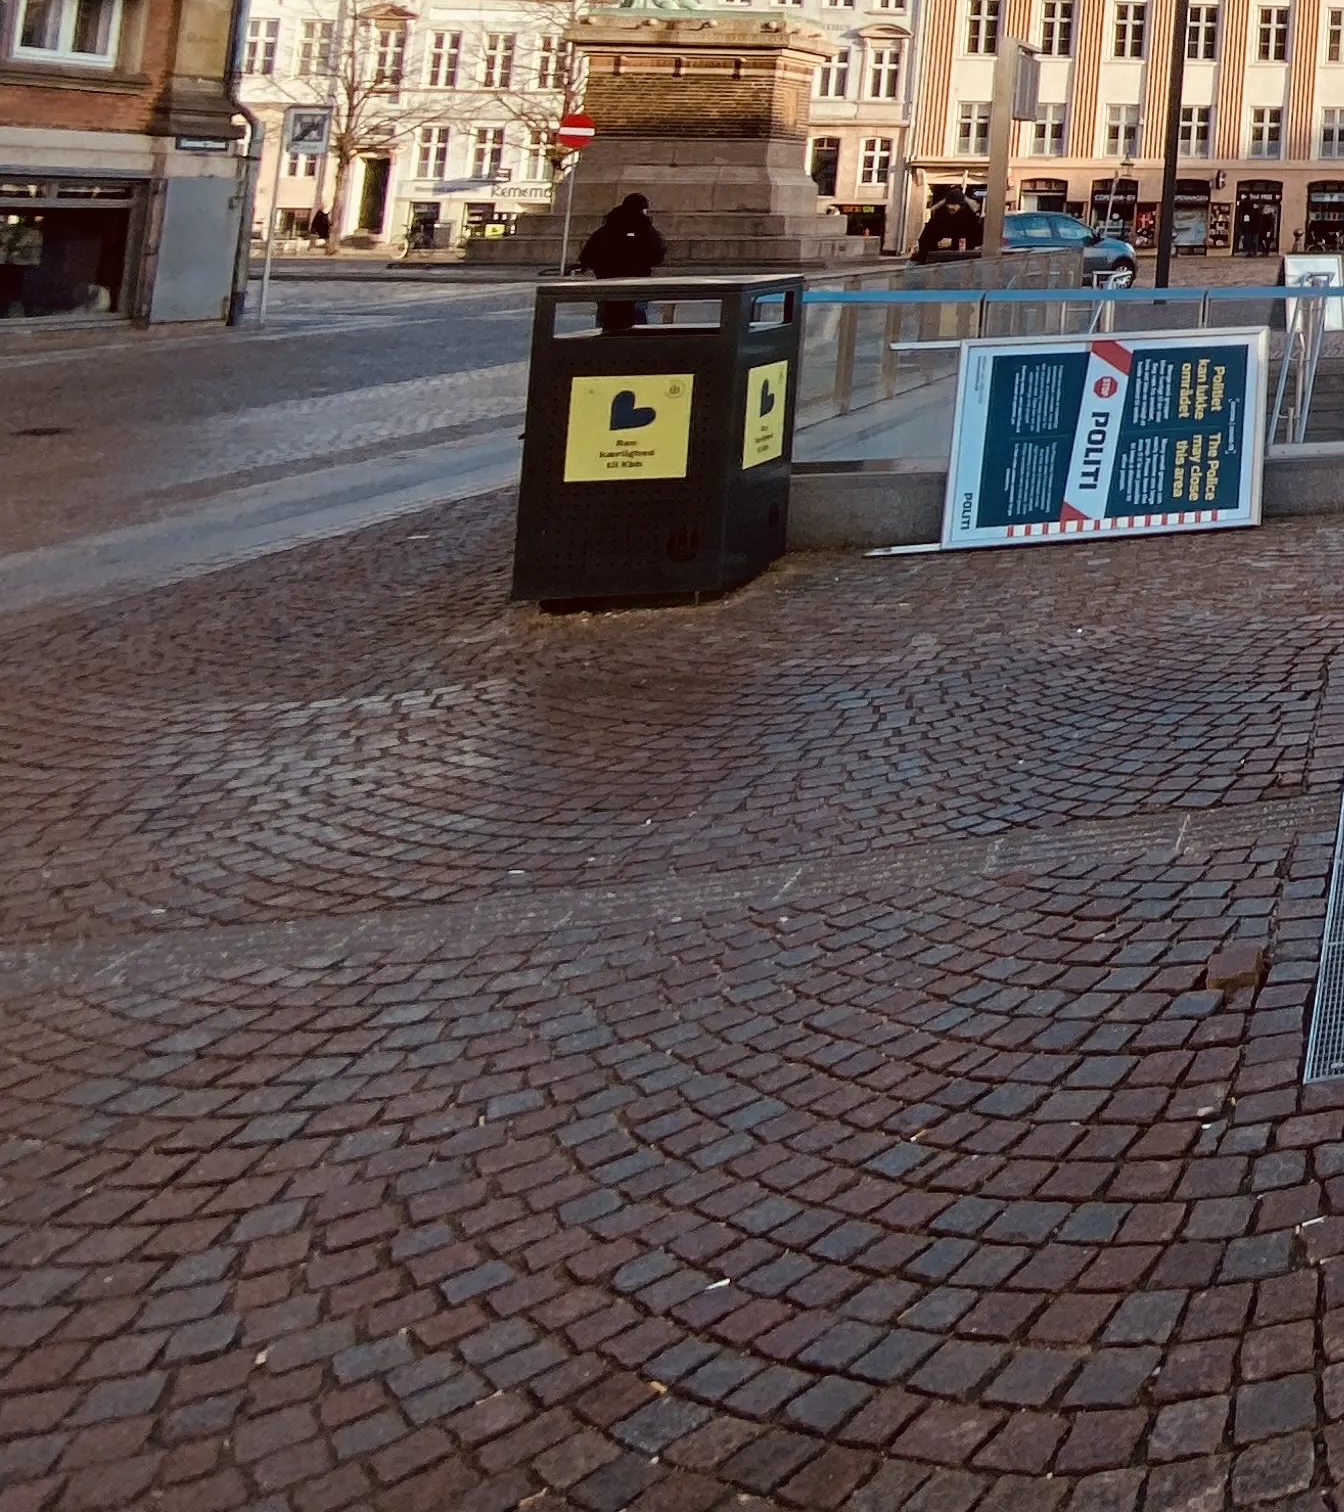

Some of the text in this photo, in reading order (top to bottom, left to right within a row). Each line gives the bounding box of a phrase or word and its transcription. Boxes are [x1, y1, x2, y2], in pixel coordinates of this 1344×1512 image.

[1178, 363, 1194, 419] området
[1194, 358, 1211, 420] kan lukke
[1079, 412, 1110, 490] POLITI
[1172, 439, 1189, 498] this area
[1188, 434, 1203, 501] may close
[1204, 432, 1221, 501] The Police
[960, 492, 973, 530] POLITI
